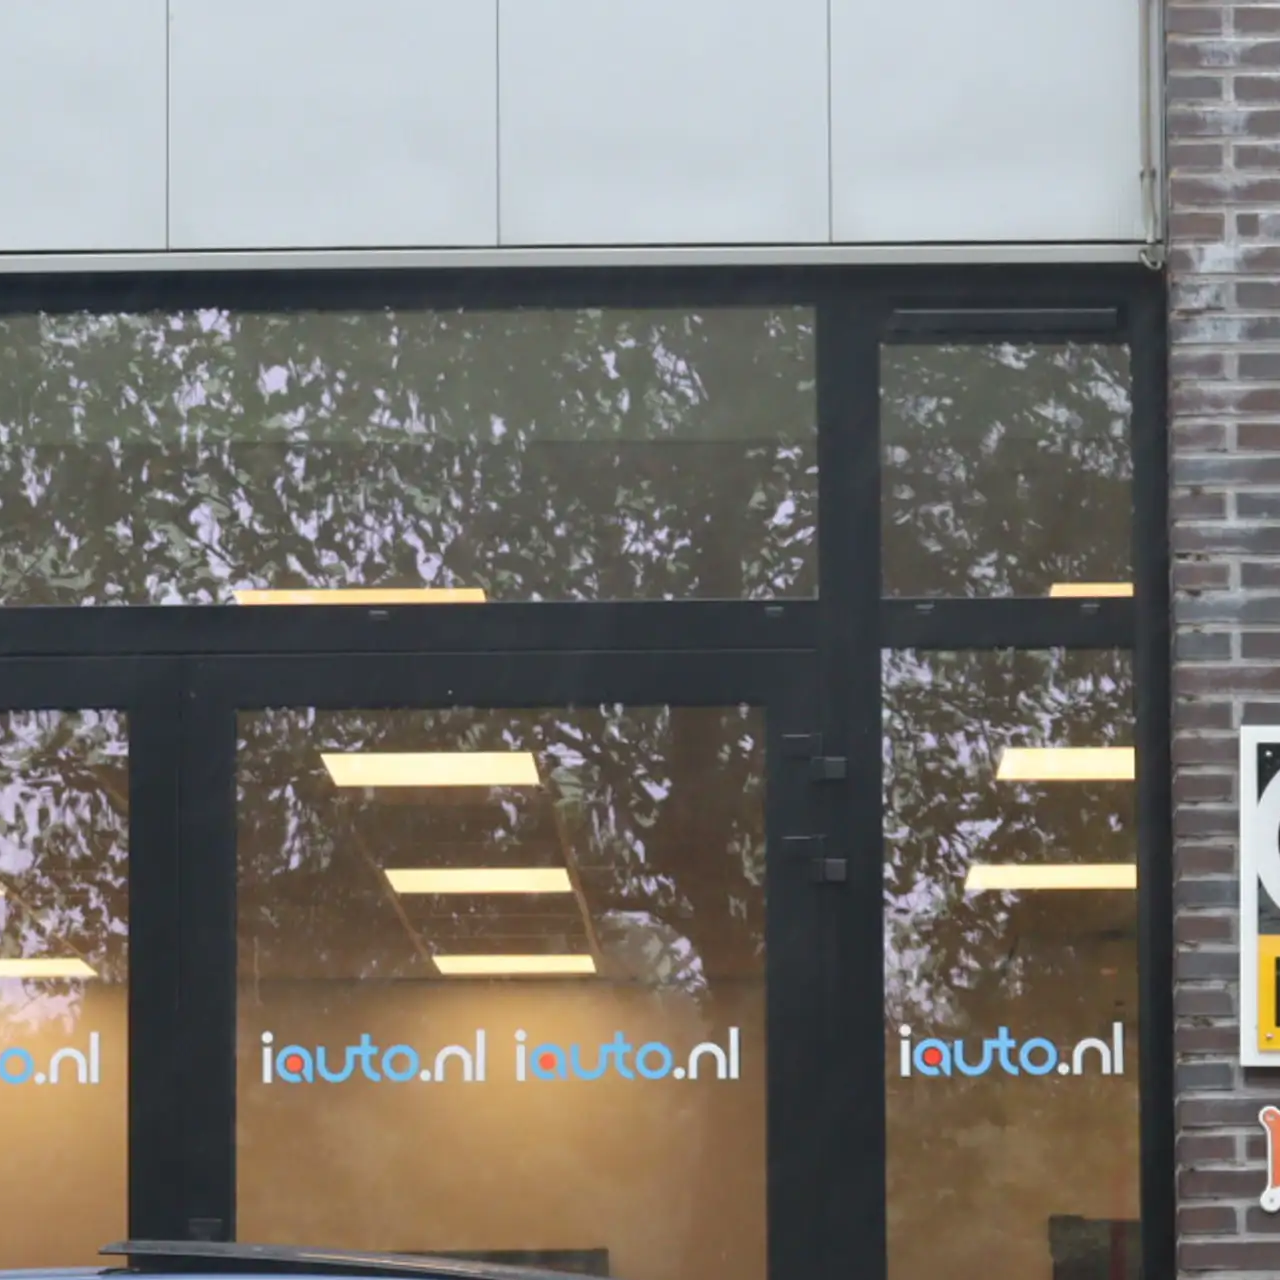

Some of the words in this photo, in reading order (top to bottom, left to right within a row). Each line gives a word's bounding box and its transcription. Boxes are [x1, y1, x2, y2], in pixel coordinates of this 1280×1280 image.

[261, 1029, 485, 1084] iauto.nl
[515, 1027, 740, 1082] iauto.nl
[899, 1022, 1124, 1078] iauto.nl
